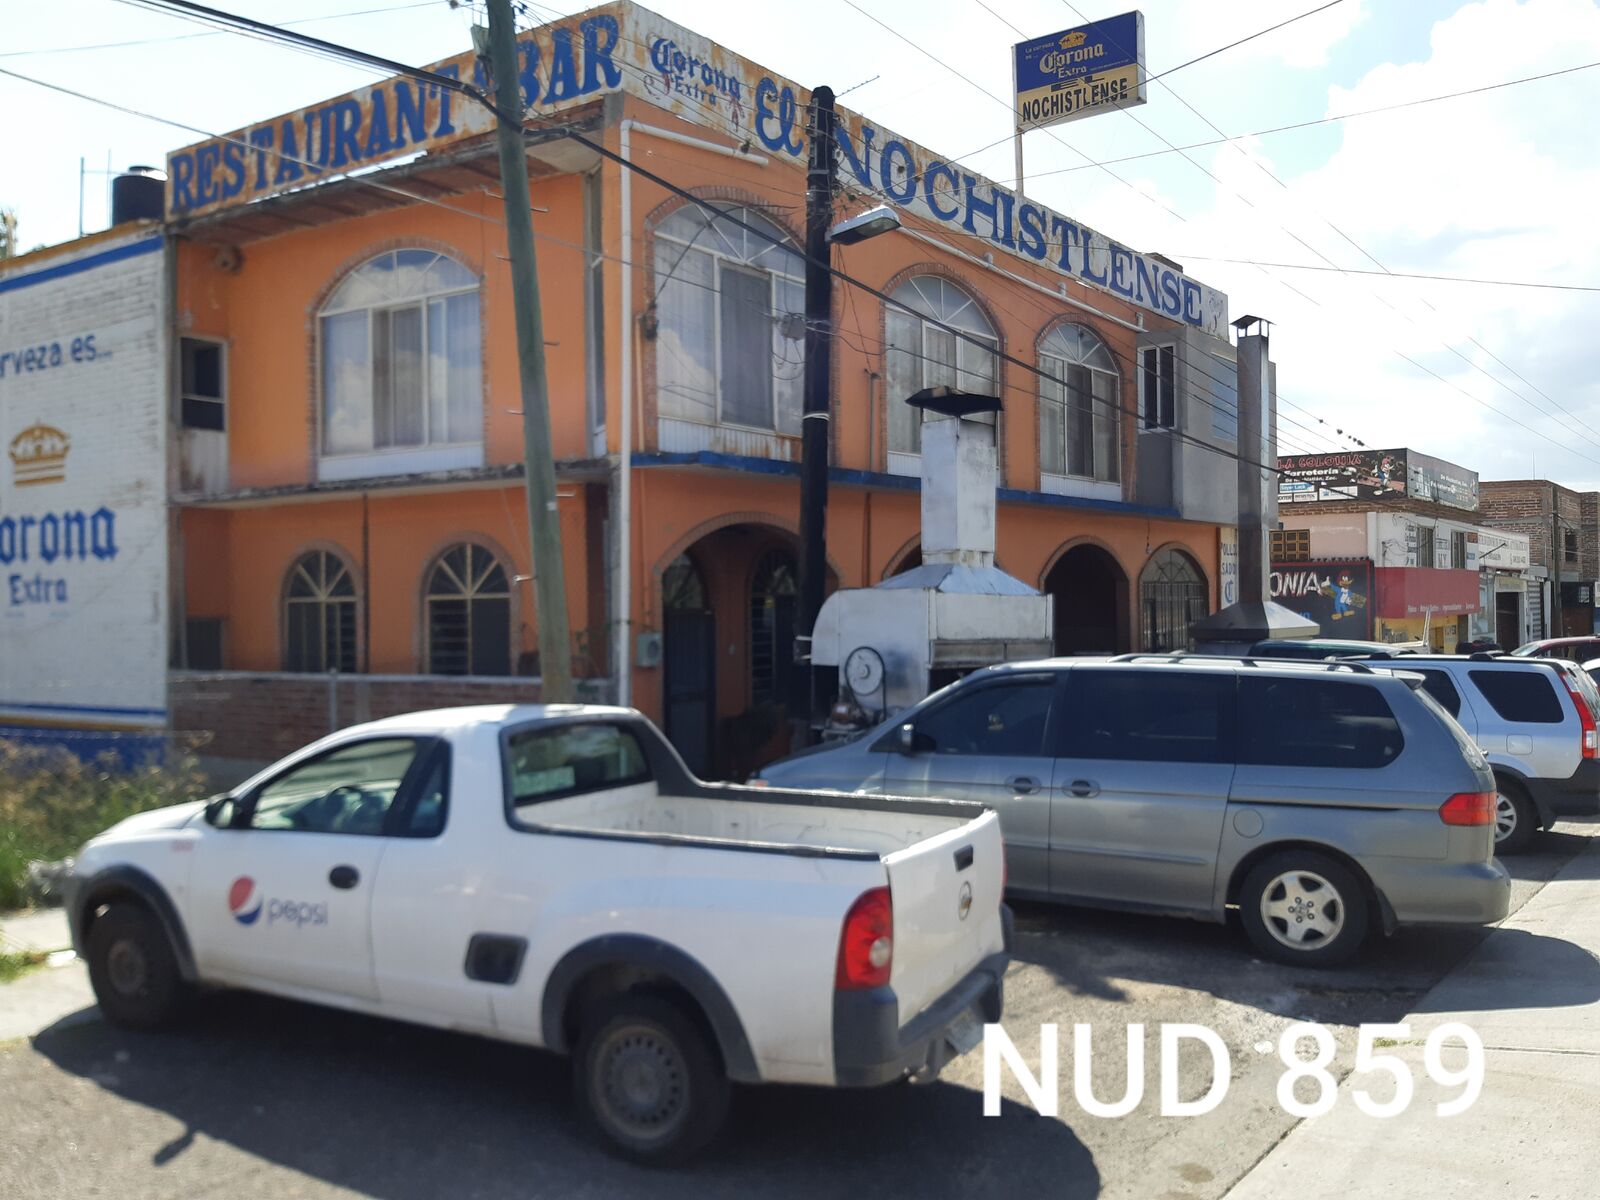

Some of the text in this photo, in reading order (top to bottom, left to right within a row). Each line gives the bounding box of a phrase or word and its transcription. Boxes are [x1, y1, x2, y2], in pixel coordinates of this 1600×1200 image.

[650, 38, 742, 101] Corona
[1039, 43, 1105, 74] Corona
[1058, 65, 1087, 78] Extra
[671, 75, 717, 106] Extra
[1022, 78, 1128, 122] NOCHISTLENSE
[169, 14, 622, 214] RESTAURANT BAR
[755, 77, 1203, 326] El NOCHISTLENSE
[0, 506, 119, 566] orona
[9, 573, 67, 606] Extra
[1270, 571, 1323, 597] ONIA
[268, 898, 328, 928] pepsi
